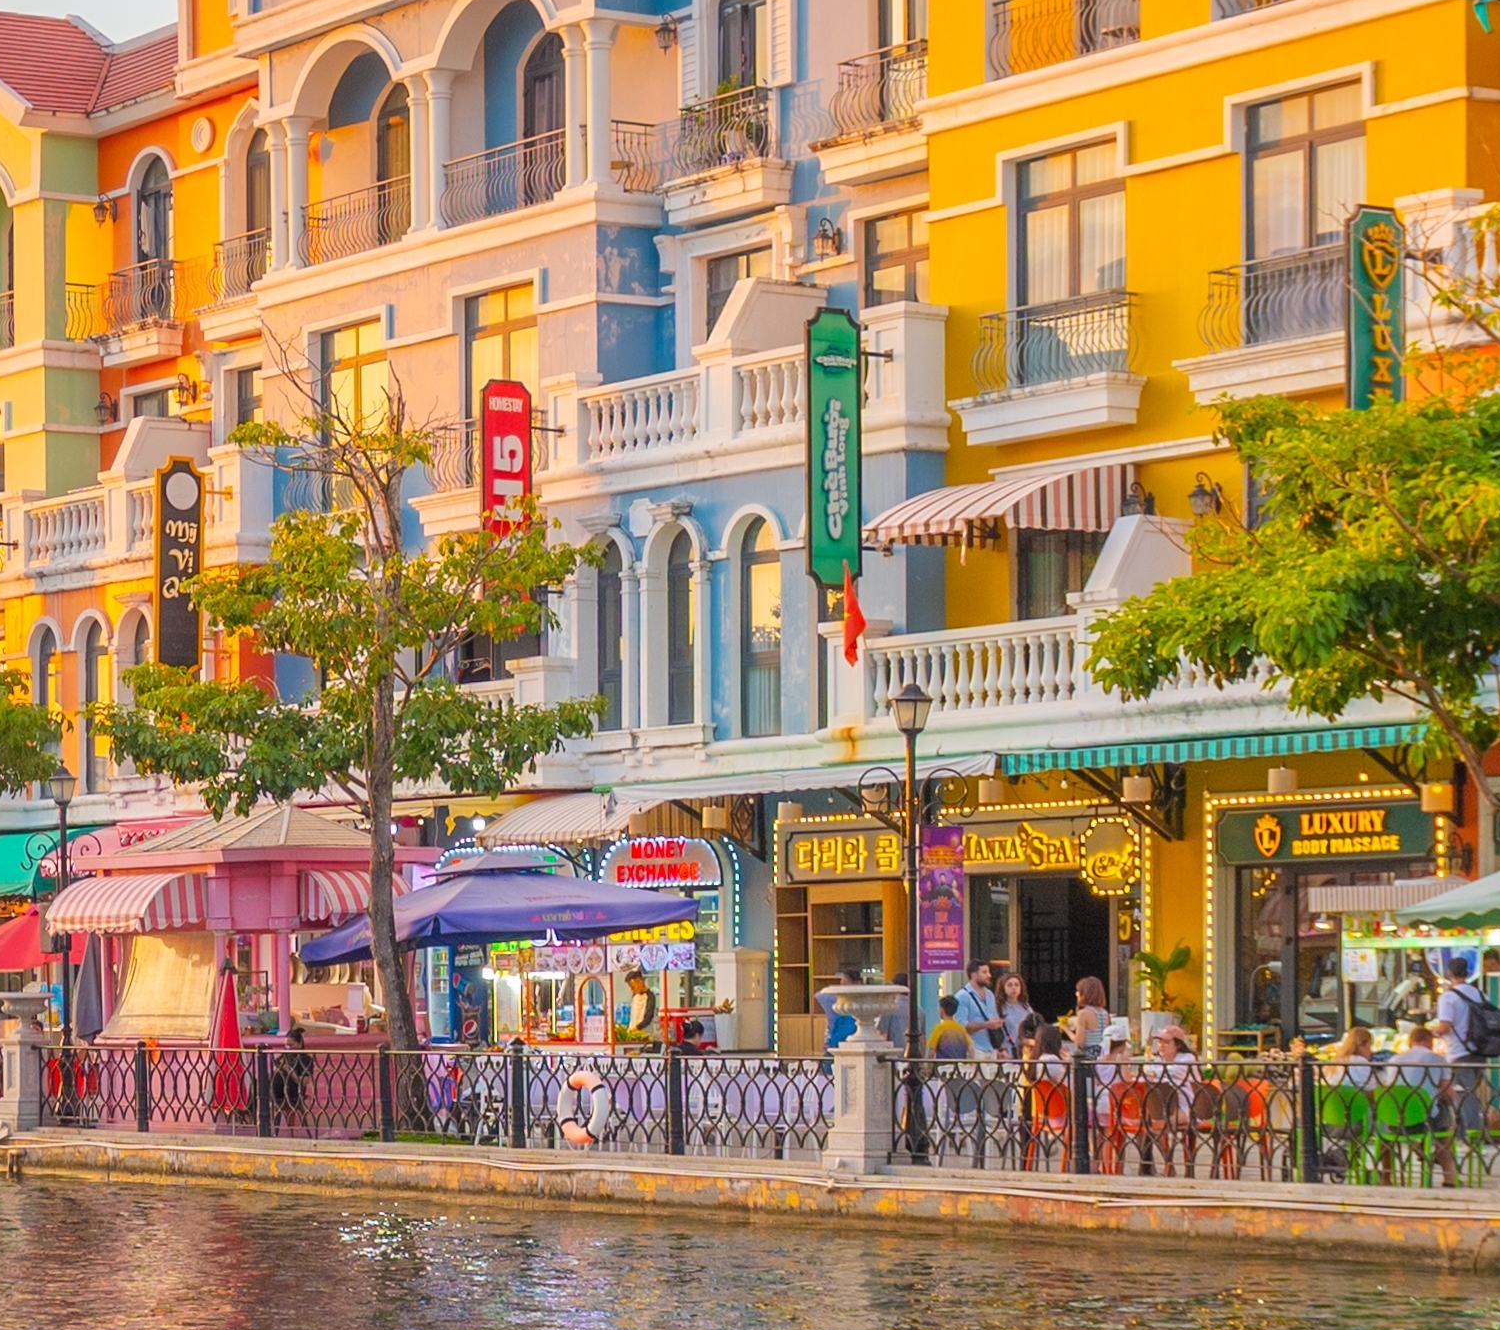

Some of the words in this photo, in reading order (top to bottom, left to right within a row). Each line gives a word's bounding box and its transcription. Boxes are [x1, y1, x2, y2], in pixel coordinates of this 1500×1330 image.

[489, 395, 524, 414] HOMESTAY
[837, 416, 850, 470] Long
[165, 519, 198, 544] Mỹ
[168, 548, 194, 574] Vị
[1300, 809, 1386, 836] LUXURY
[631, 840, 687, 860] MONEY
[794, 835, 868, 874] 다리와
[1028, 830, 1074, 870] SPA
[1292, 839, 1328, 856] BODY
[1329, 834, 1401, 854] MASSAGE
[616, 862, 700, 883] EXCHANGE
